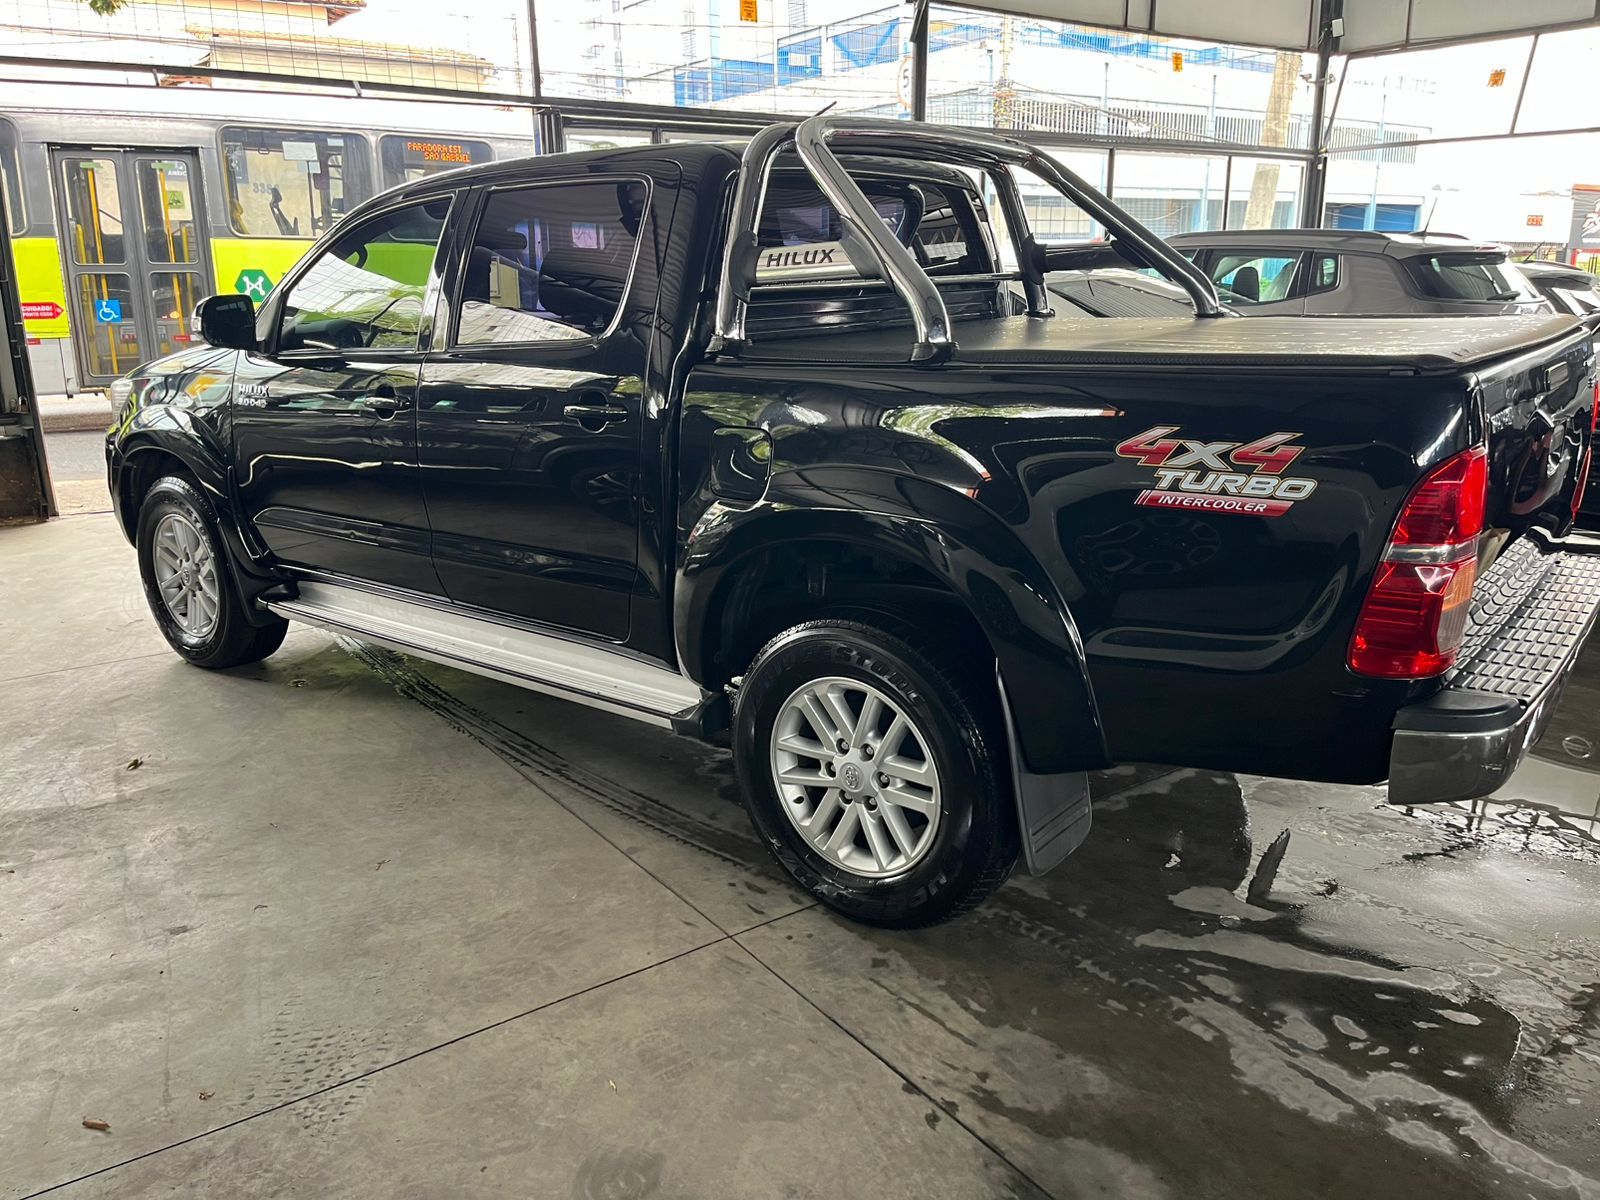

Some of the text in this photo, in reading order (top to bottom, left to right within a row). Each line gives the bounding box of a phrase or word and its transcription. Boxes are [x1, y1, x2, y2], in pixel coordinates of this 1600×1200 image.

[441, 153, 470, 163] GABRIEL
[766, 248, 835, 267] HILUX
[238, 384, 269, 398] HILUX
[1154, 468, 1318, 501] TURBO
[1157, 495, 1267, 513] INTERCOOLER
